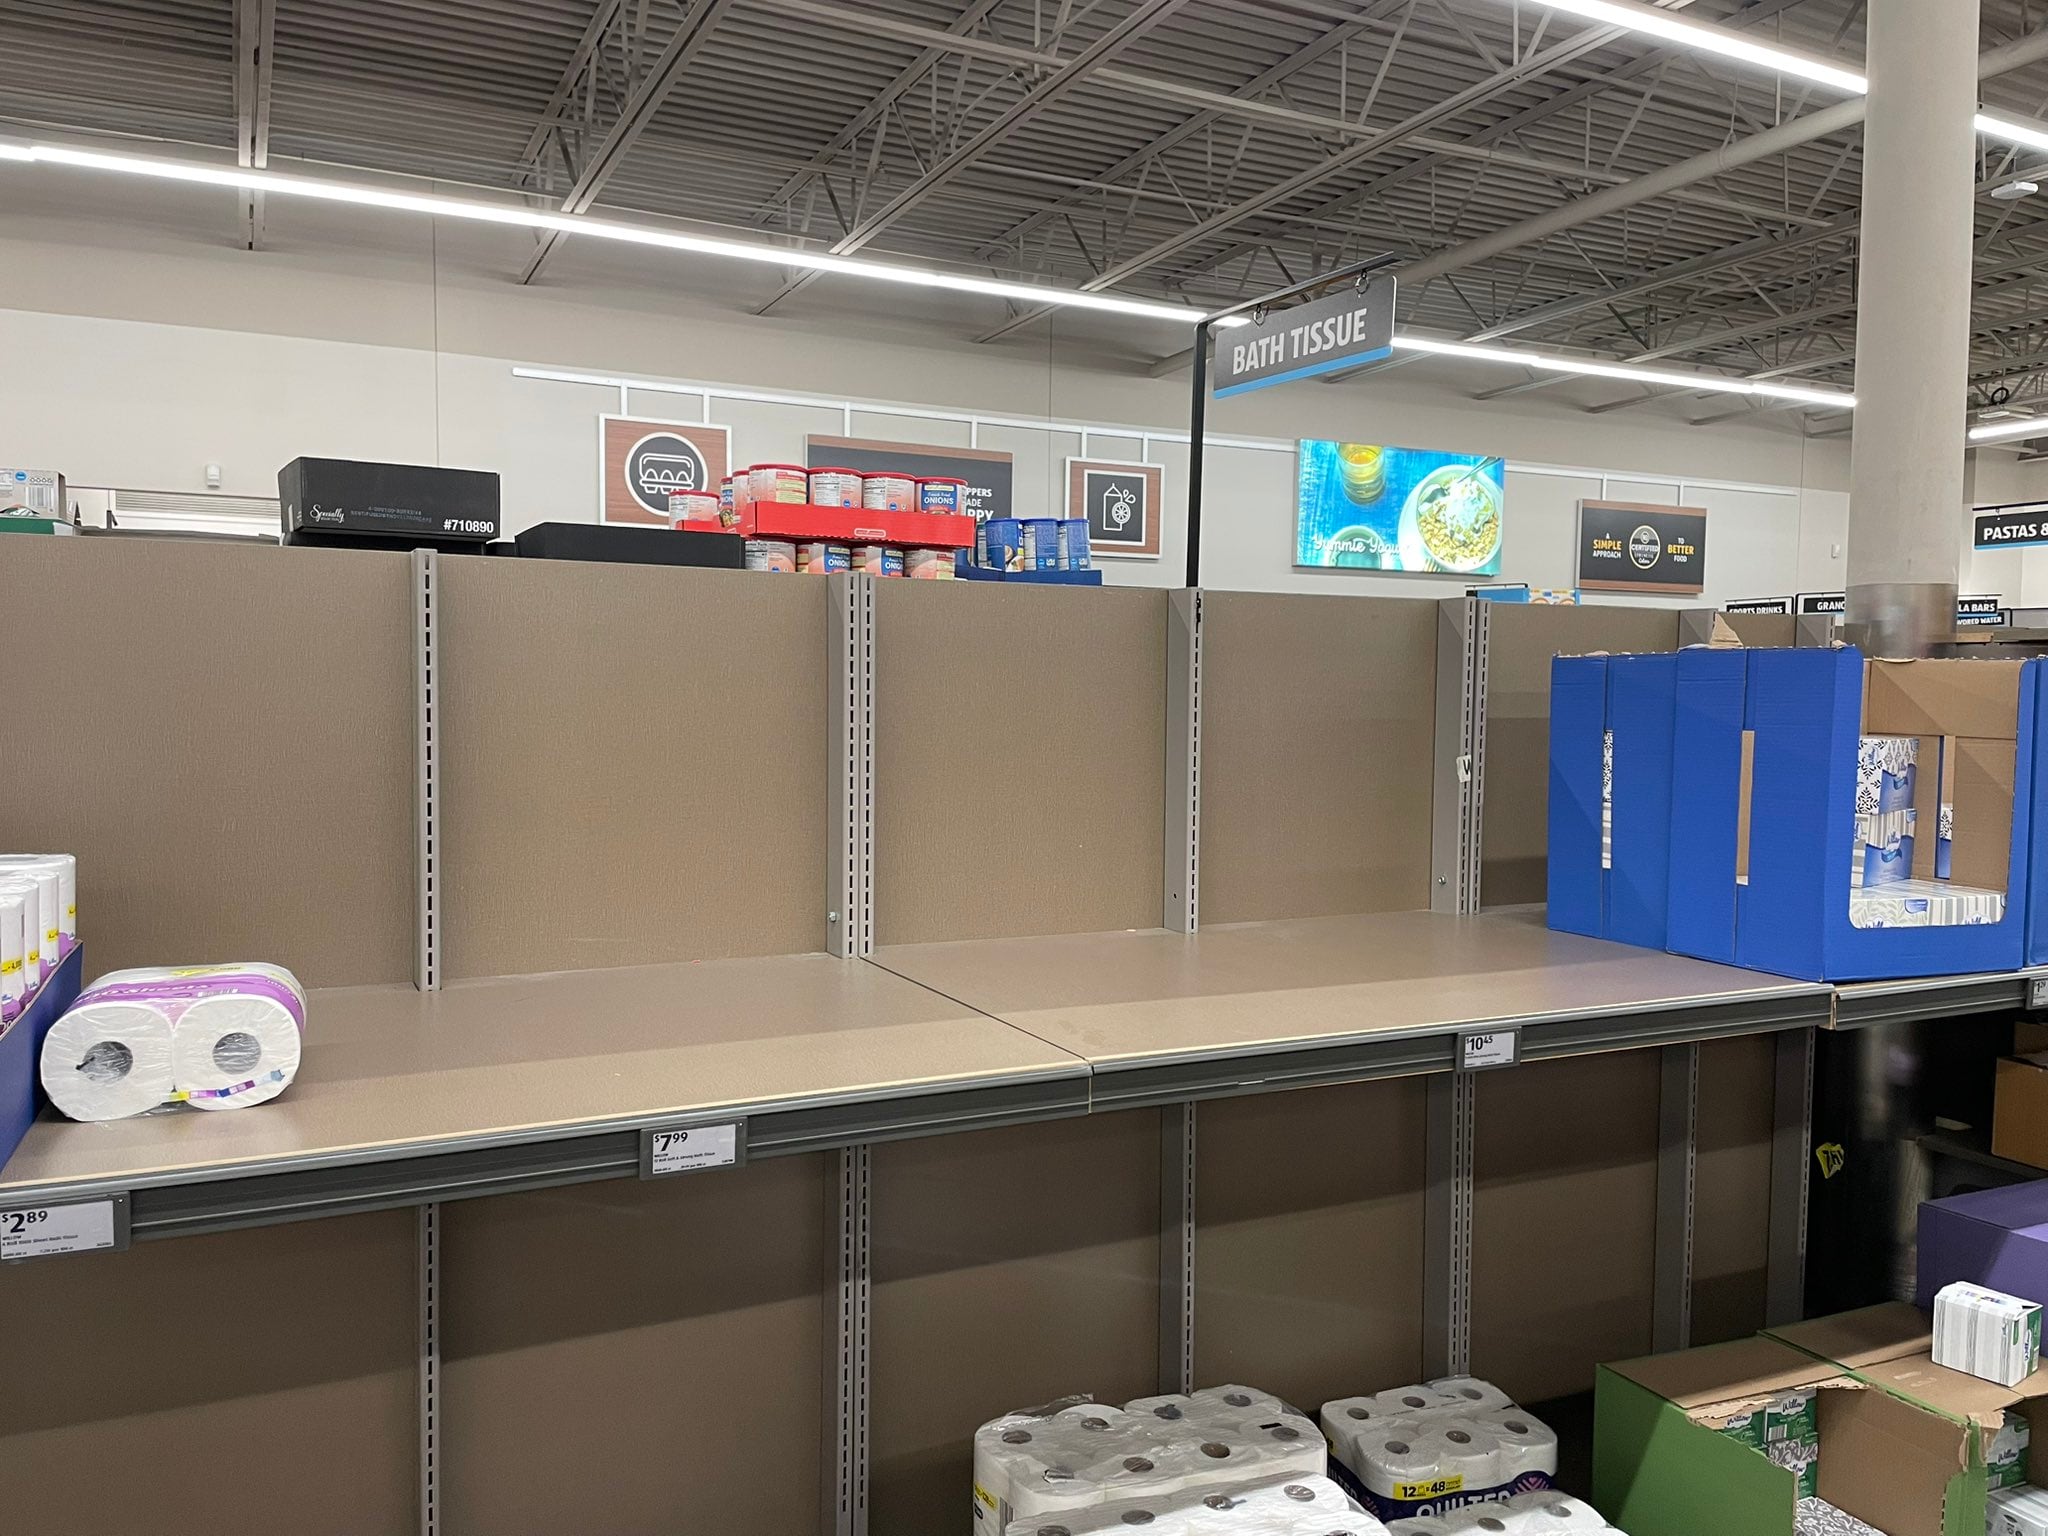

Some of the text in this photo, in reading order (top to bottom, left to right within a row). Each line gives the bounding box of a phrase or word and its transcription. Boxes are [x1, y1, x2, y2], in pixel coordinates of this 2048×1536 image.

[1232, 307, 1368, 376] BATH TISSUE
[966, 487, 993, 498] PPERS
[924, 496, 954, 505] ONIONS
[967, 498, 982, 508] ADE
[967, 508, 994, 522] PPY
[443, 519, 494, 534] #710890
[1983, 523, 2037, 541] PASTAS
[1593, 539, 1622, 550] SIMPLE
[1667, 544, 1694, 555] BETTER
[1592, 550, 1621, 559] APPROACH
[1673, 555, 1687, 563] FOOD
[1756, 605, 1783, 614] DRINKS
[1971, 603, 1995, 612] BARS
[1402, 1486, 1417, 1498] 12
[1430, 1481, 1446, 1493] 48
